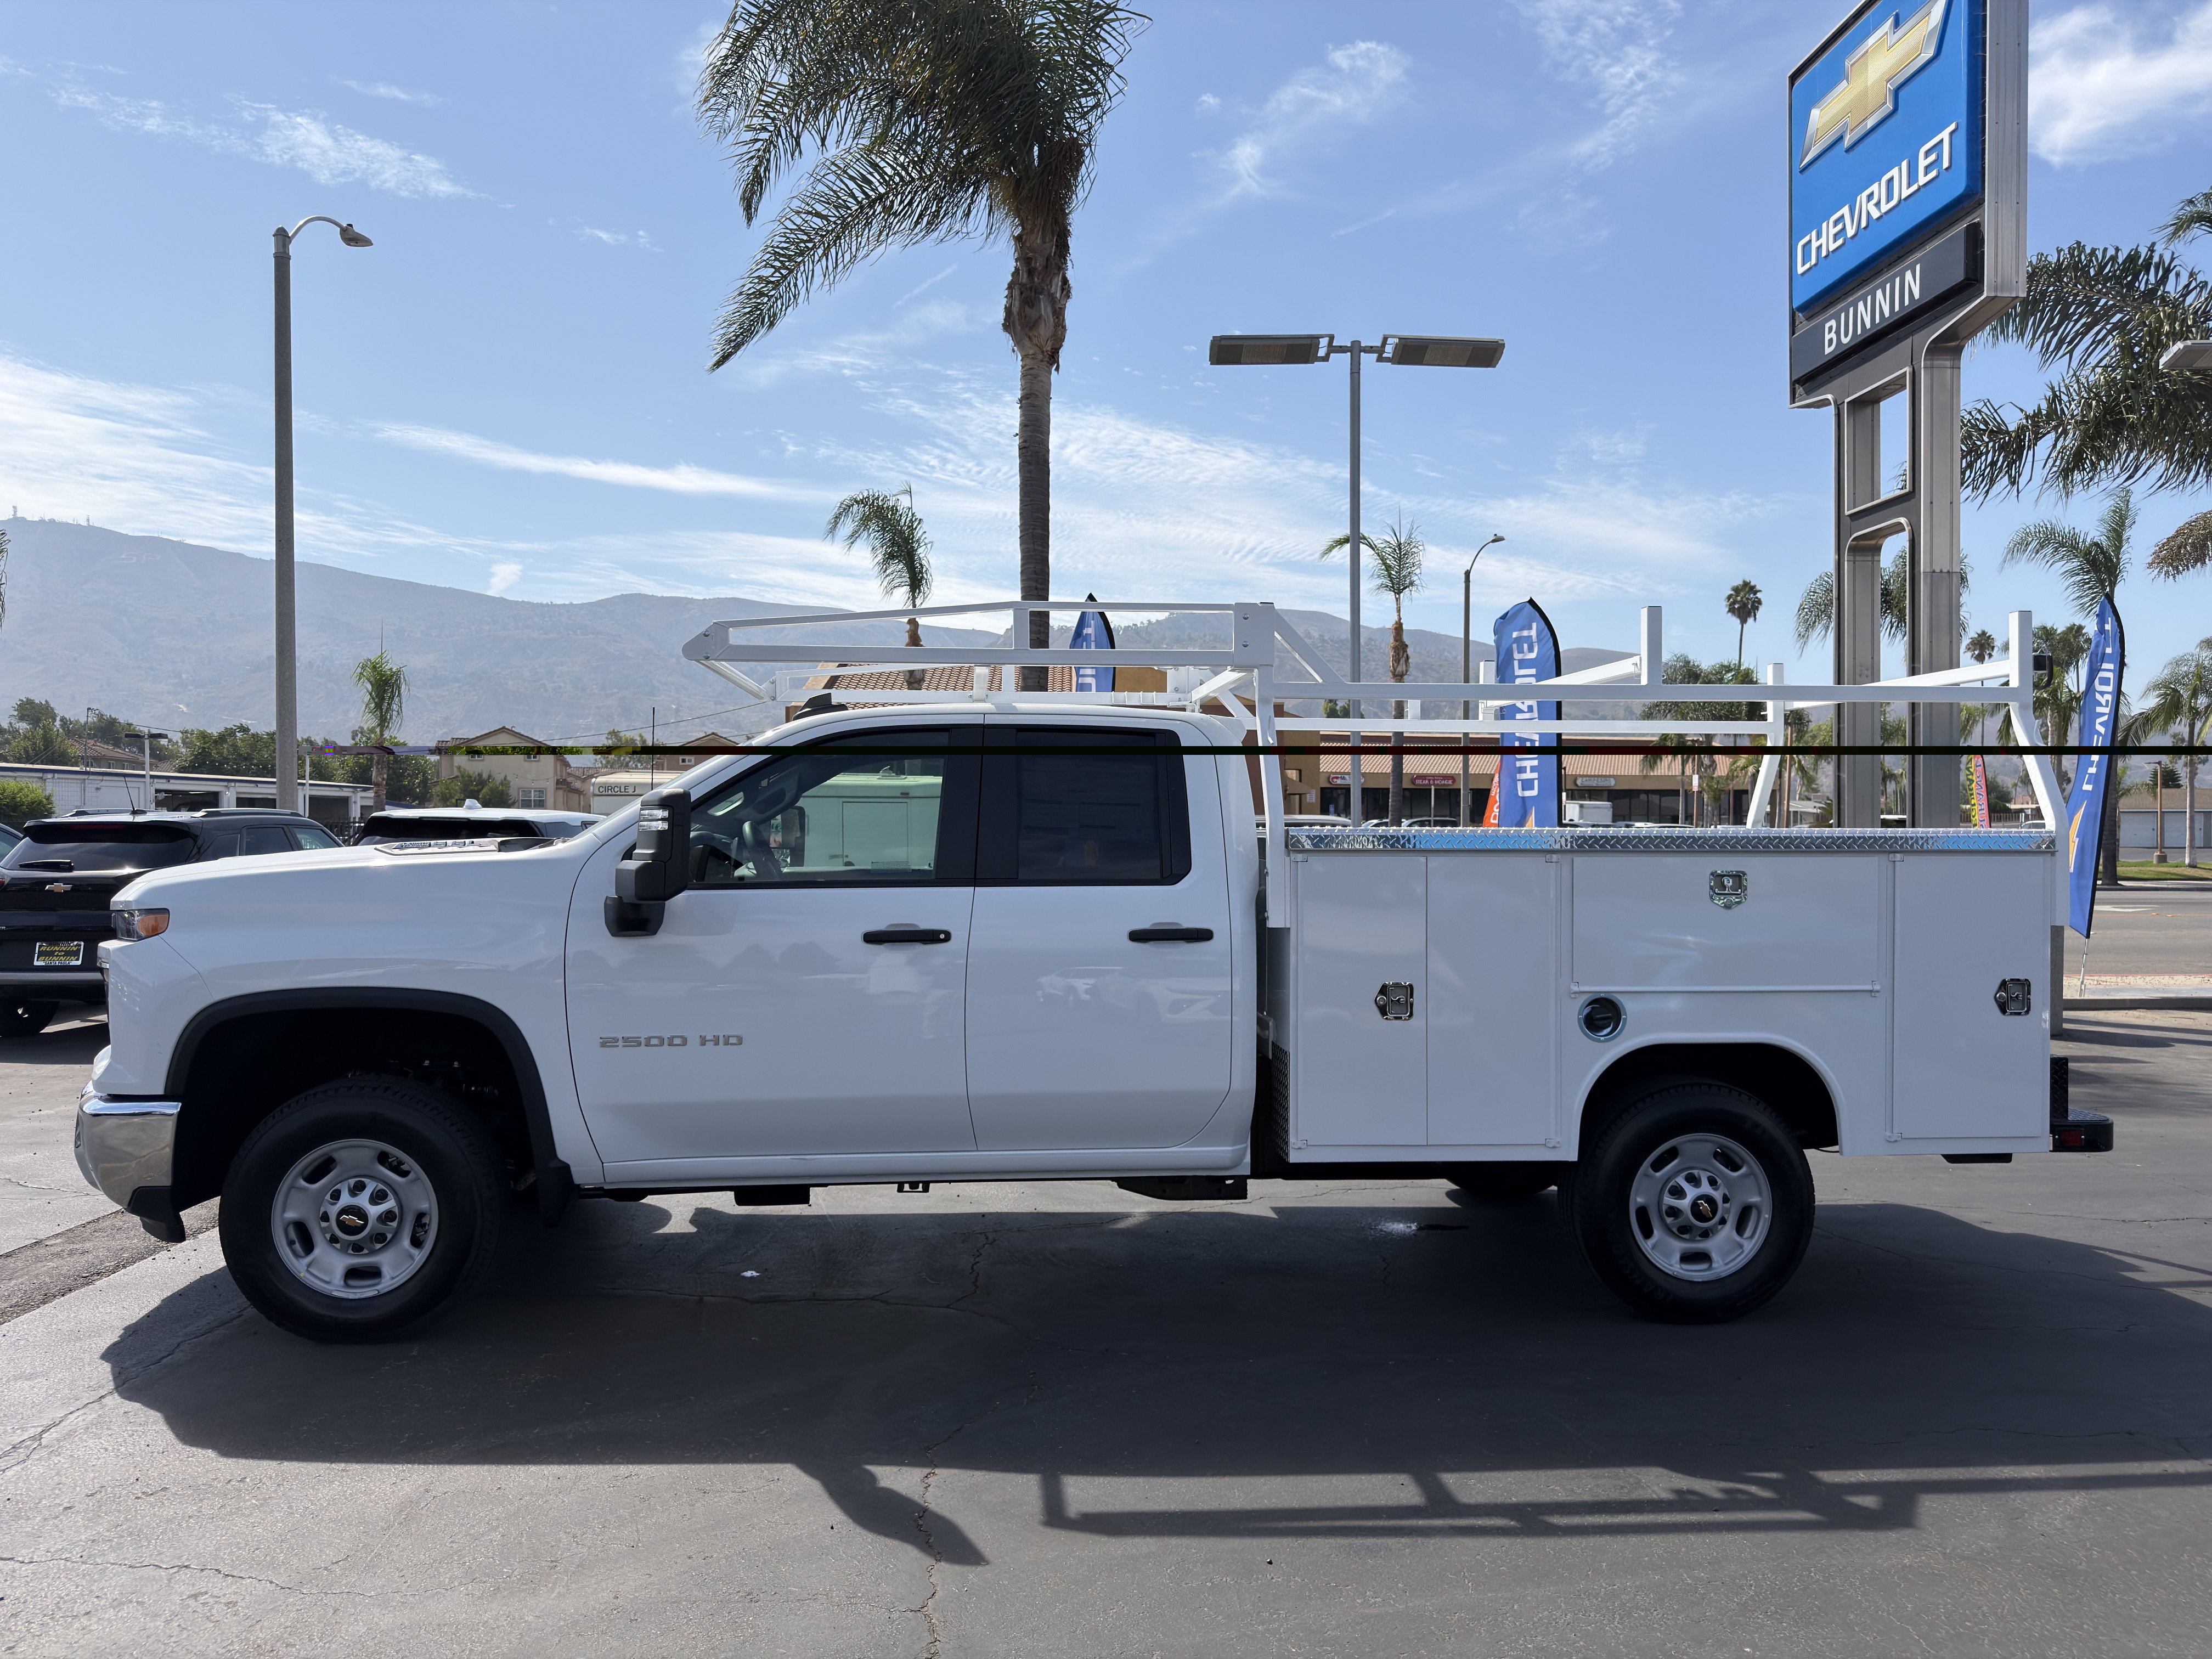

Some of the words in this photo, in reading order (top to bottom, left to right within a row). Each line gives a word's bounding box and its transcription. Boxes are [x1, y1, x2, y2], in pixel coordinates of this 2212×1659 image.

[1797, 121, 1957, 275] CHEVROLET
[1824, 263, 1920, 355] BUNNIN
[599, 1035, 687, 1048] 2500
[699, 1034, 743, 1046] HD
